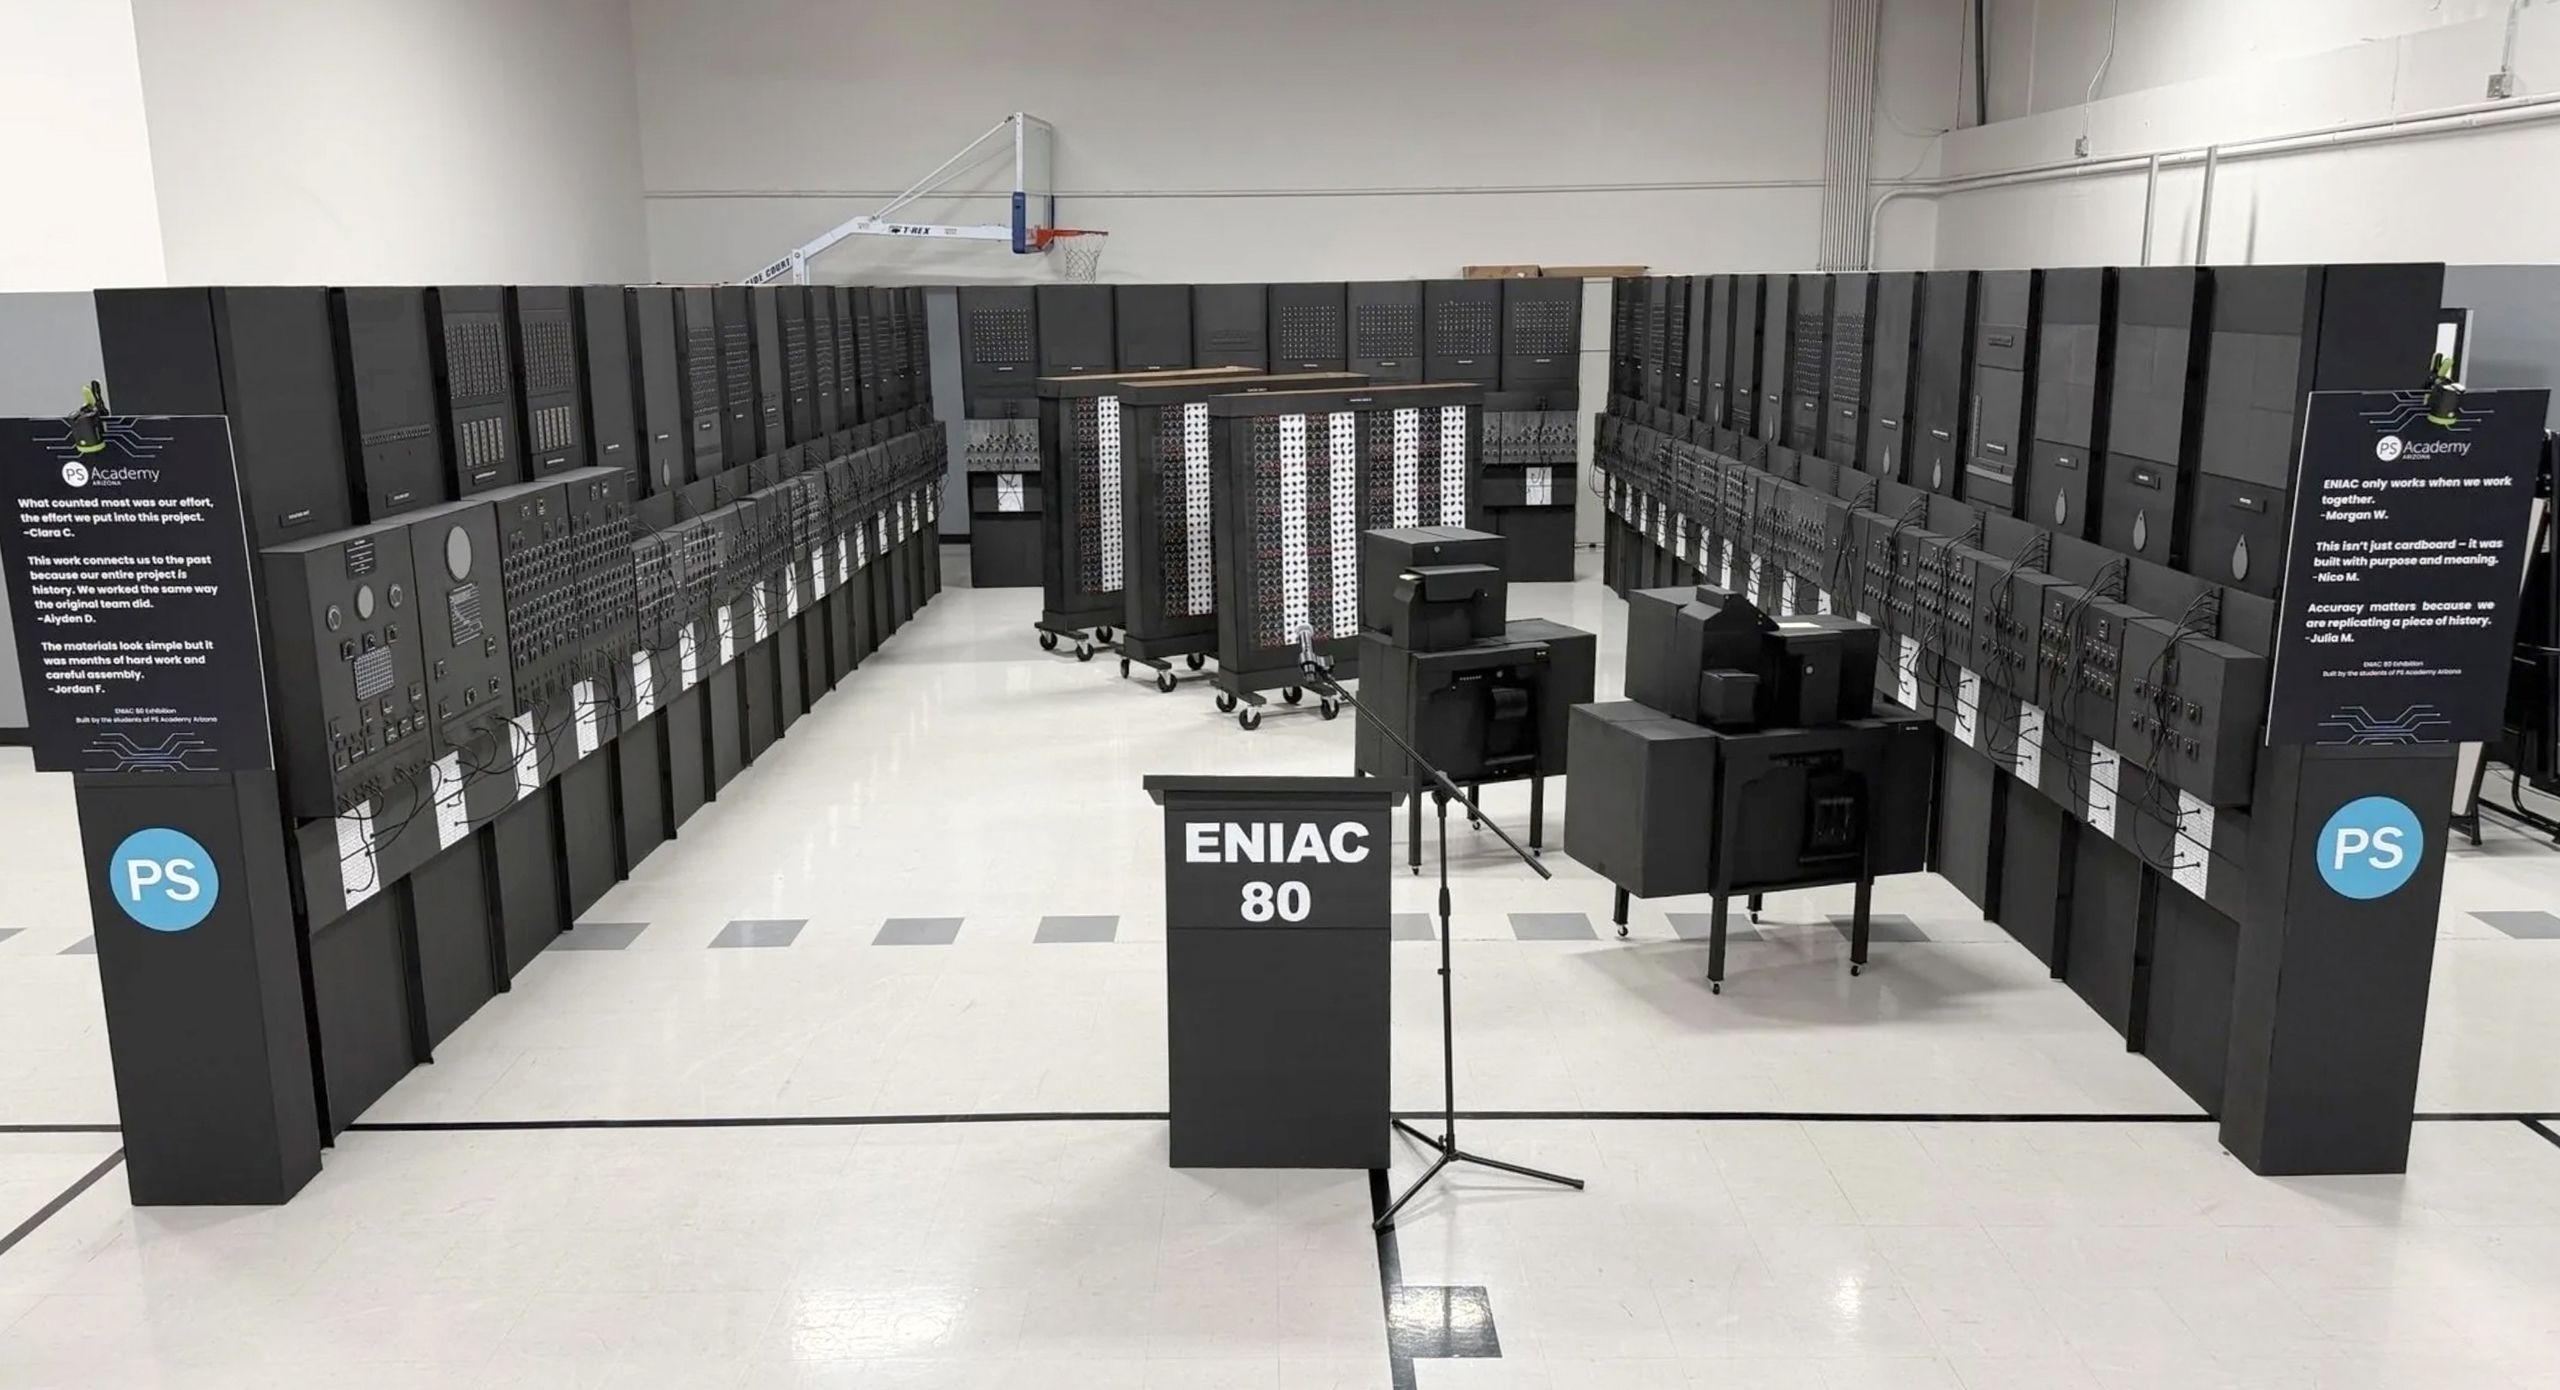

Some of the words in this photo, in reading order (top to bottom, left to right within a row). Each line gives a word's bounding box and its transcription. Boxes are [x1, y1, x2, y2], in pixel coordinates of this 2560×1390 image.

[766, 258, 790, 277] COURT
[2380, 442, 2398, 455] PS
[2403, 441, 2471, 456] Academy
[66, 469, 84, 481] PS
[92, 467, 159, 482] Academy
[2324, 480, 2359, 489] ENIAC
[2362, 479, 2387, 491] only
[2390, 478, 2425, 487] works
[2429, 478, 2460, 487] when
[2464, 478, 2480, 486] we
[2483, 476, 2512, 486] work
[18, 499, 49, 508] What
[52, 498, 98, 508] counted
[101, 499, 130, 507] most
[158, 499, 177, 507] our
[179, 497, 213, 508] effort,
[2322, 495, 2375, 507] together.
[21, 514, 39, 523] the
[42, 513, 72, 523] effort
[74, 514, 90, 522] we
[93, 513, 112, 525] put
[114, 513, 136, 522] into
[138, 512, 159, 522] this
[162, 512, 204, 524] project.
[2321, 511, 2371, 523] -Morgan
[2374, 510, 2388, 519] W.
[23, 528, 61, 537] -Clara
[63, 528, 75, 537] C.
[2316, 541, 2339, 551] This
[2369, 540, 2392, 553] just
[2395, 540, 2456, 550] cardboard
[2468, 539, 2477, 548] it
[2479, 540, 2503, 548] was
[28, 556, 51, 565] This
[53, 556, 81, 565] work
[83, 556, 135, 565] connects
[152, 556, 164, 564] to
[166, 556, 184, 564] the
[186, 556, 212, 566] past
[2314, 557, 2340, 567] built
[2342, 556, 2368, 566] with
[2369, 557, 2417, 568] purpose
[2419, 556, 2442, 565] and
[2444, 554, 2499, 566] meaning.
[30, 571, 78, 580] because
[80, 572, 99, 580] our
[101, 570, 134, 580] entire
[136, 570, 176, 581] project
[178, 569, 187, 579] is
[2313, 572, 2344, 582] -Nico
[2346, 573, 2359, 582] M.
[32, 585, 75, 597] history.
[77, 585, 95, 594] We
[97, 585, 138, 594] worked
[141, 585, 159, 593] the
[161, 585, 192, 593] same
[195, 585, 218, 595] way
[35, 600, 53, 609] the
[55, 600, 98, 611] original
[100, 600, 130, 608] team
[132, 599, 154, 608] did.
[2308, 603, 2364, 614] Accuracy
[2370, 602, 2416, 612] matters
[2422, 601, 2472, 611] because
[2477, 601, 2495, 610] we
[85, 614, 96, 623] D.
[2306, 619, 2326, 628] are
[2328, 617, 2391, 630] replicating
[2392, 618, 2400, 626] a
[2402, 617, 2433, 629] piece
[2435, 616, 2447, 626] of
[2449, 615, 2492, 627] history.
[2305, 634, 2339, 643] -Julia
[2341, 634, 2354, 643] M.
[41, 642, 62, 651] The
[64, 641, 117, 650] materials
[120, 641, 143, 650] look
[145, 641, 182, 652] simple
[185, 641, 203, 650] but
[205, 641, 213, 649] it
[44, 657, 66, 665] was
[69, 656, 111, 665] months
[113, 656, 124, 664] of
[126, 655, 152, 664] hard
[154, 655, 182, 664] work
[184, 655, 206, 664] and
[46, 670, 85, 679] careful
[87, 670, 144, 681] assembly.
[48, 685, 93, 693] -Jordan
[96, 685, 105, 693] F.
[1185, 821, 1370, 863] ENIAC
[2334, 827, 2404, 870] PS
[128, 858, 199, 901] PS
[1241, 881, 1311, 922] 80
